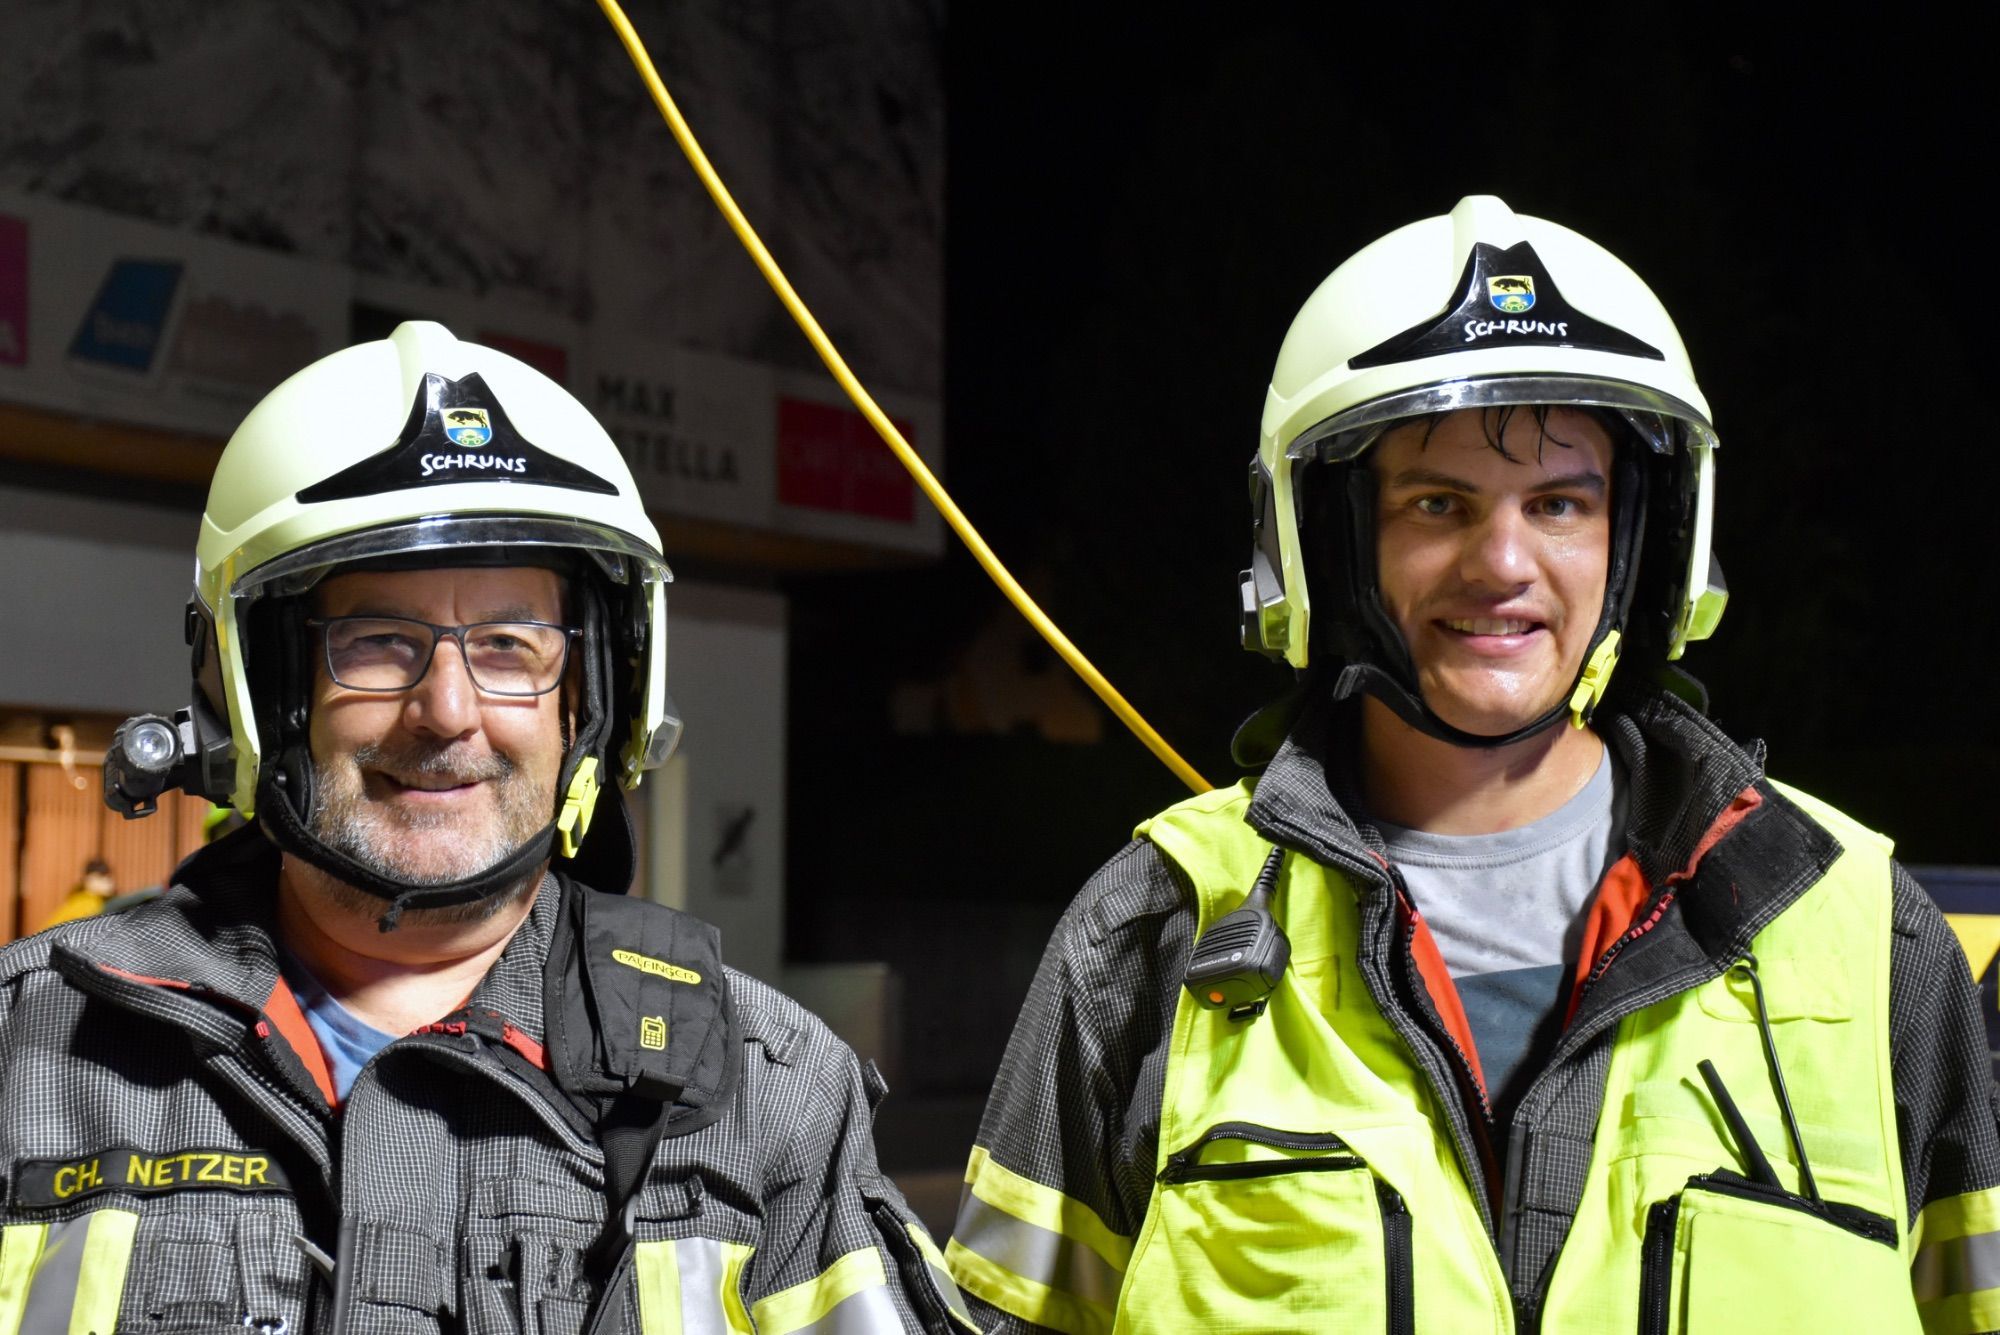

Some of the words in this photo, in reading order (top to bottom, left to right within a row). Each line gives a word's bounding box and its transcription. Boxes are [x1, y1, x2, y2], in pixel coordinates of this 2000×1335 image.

[1464, 320, 1568, 342] SCHRUNS
[597, 374, 677, 420] MAX
[420, 453, 527, 476] SCHRUNS
[617, 951, 695, 982] PALFINGER
[53, 1158, 104, 1198] CH.
[126, 1153, 270, 1187] NETZER
